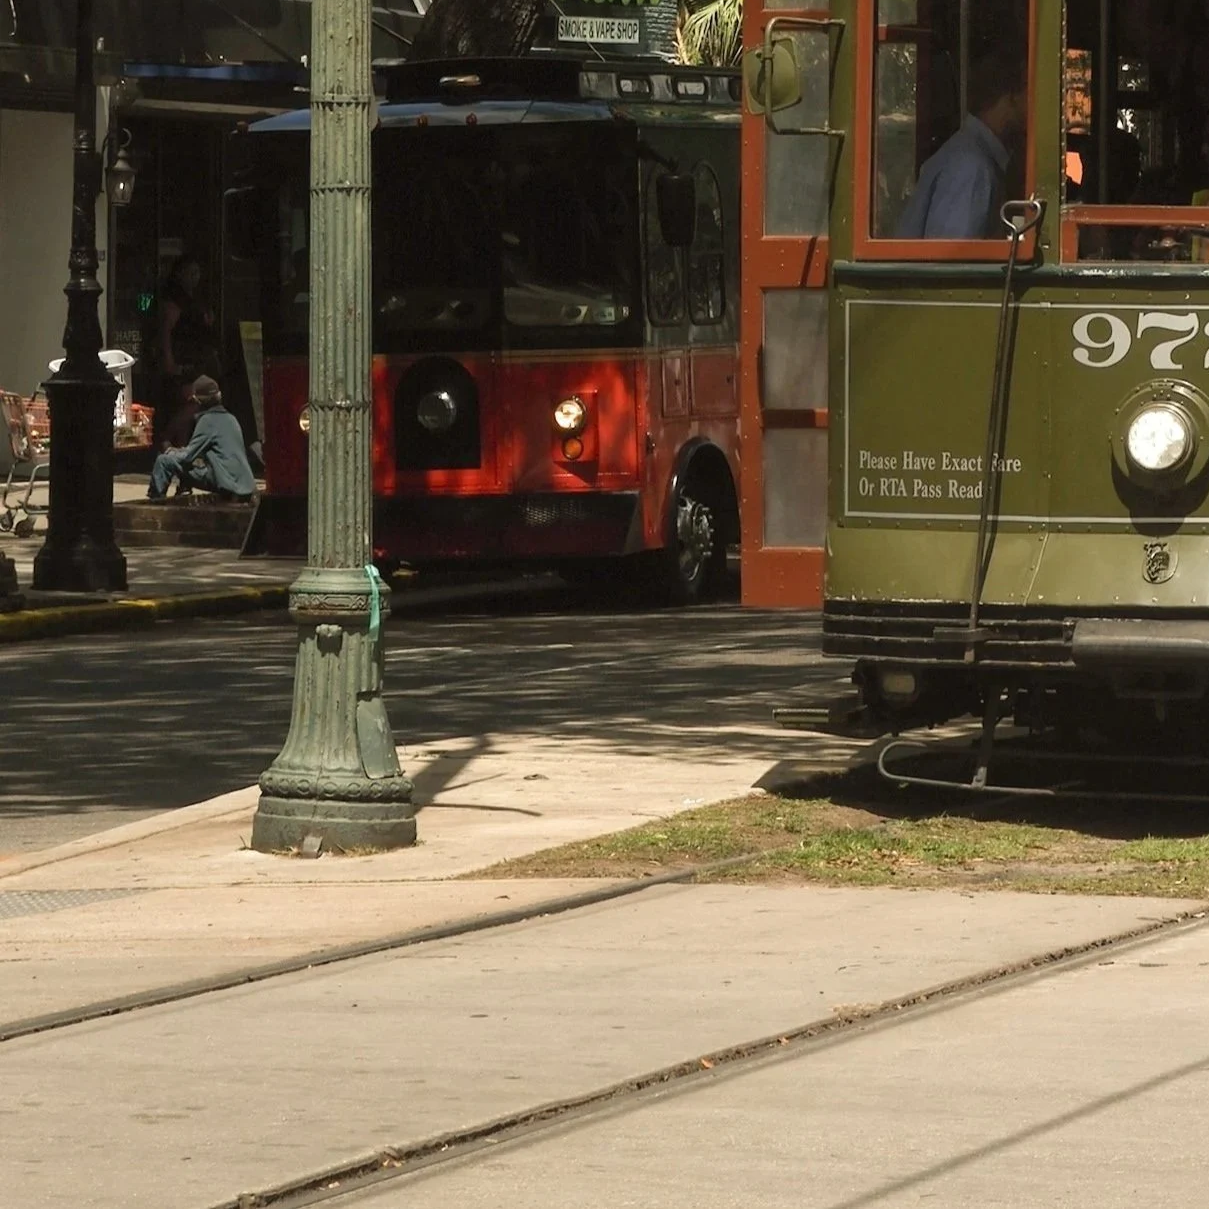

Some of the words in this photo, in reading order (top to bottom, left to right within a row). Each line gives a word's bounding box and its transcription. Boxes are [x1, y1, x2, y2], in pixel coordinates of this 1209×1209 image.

[560, 20, 587, 38] SMOKE
[589, 22, 594, 39] &
[595, 20, 615, 39] VAPE
[618, 22, 638, 40] SHOP
[859, 450, 897, 469] Please
[902, 451, 936, 470] Have
[942, 452, 982, 472] Exact
[859, 477, 875, 495] Or
[880, 478, 908, 497] RTA
[913, 479, 942, 498] Pass
[948, 479, 992, 499] Read
